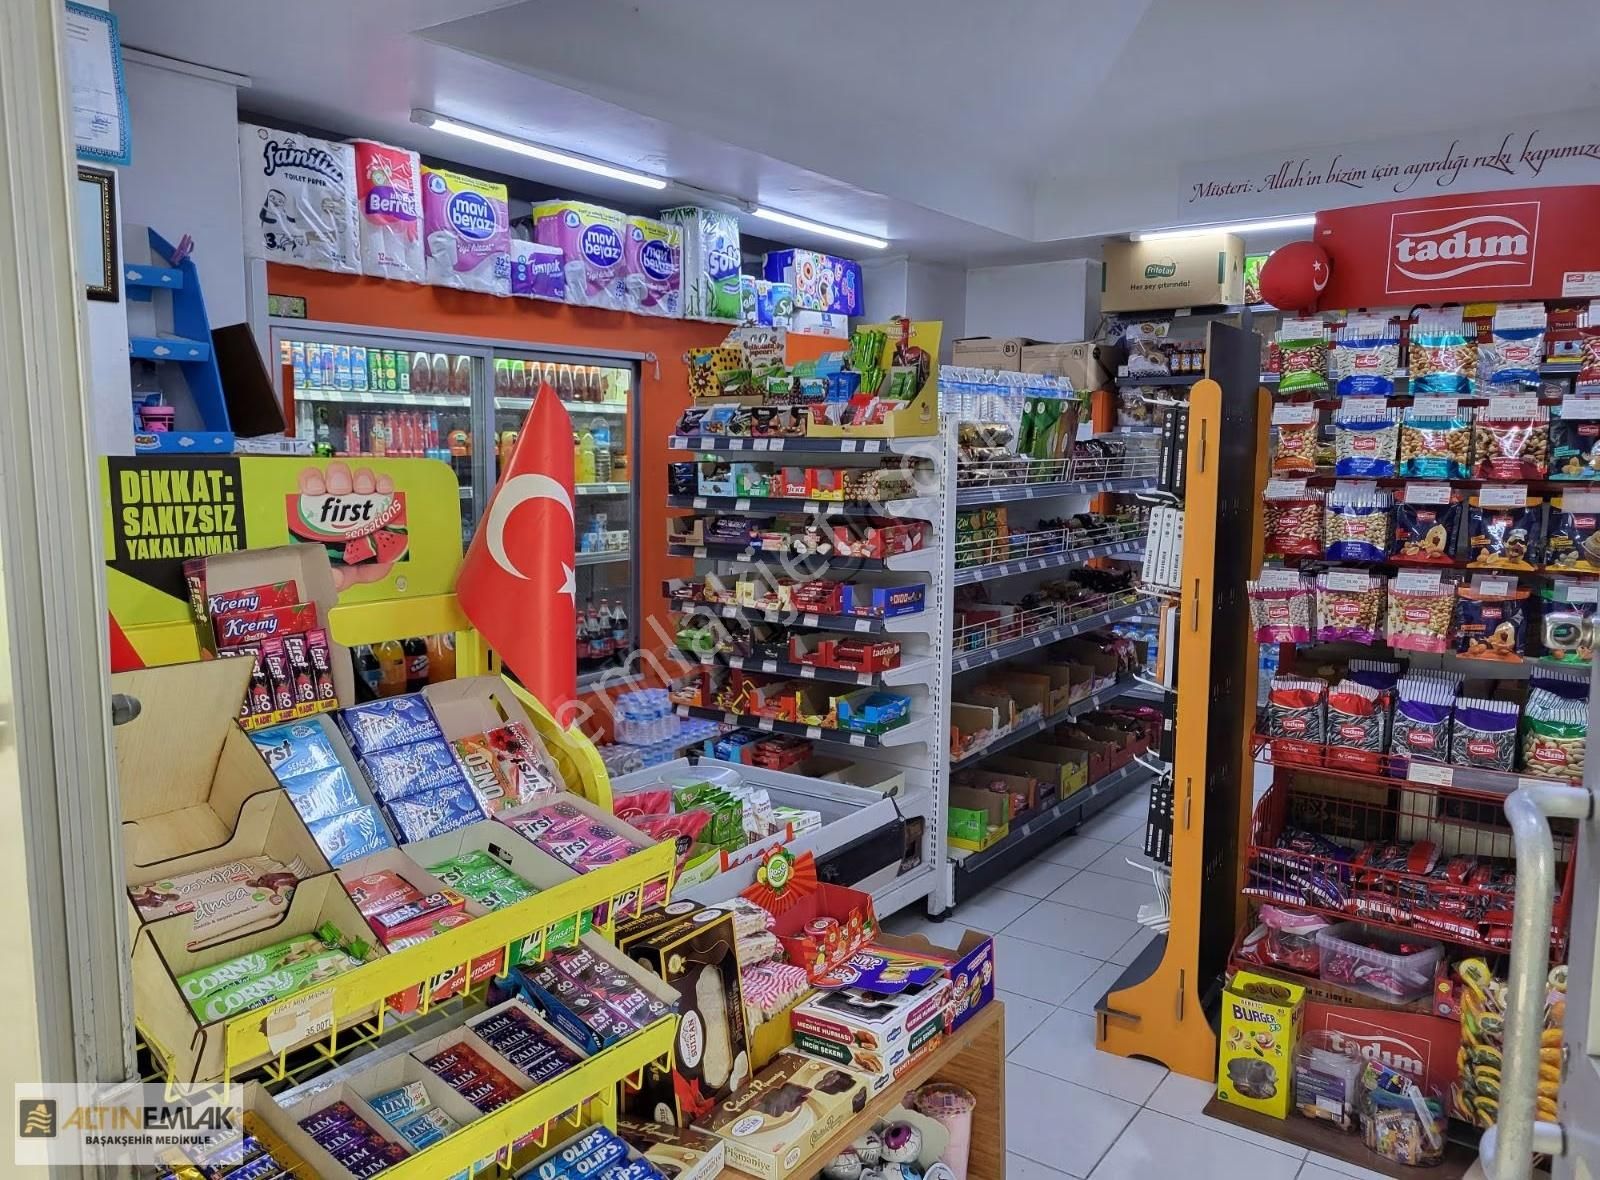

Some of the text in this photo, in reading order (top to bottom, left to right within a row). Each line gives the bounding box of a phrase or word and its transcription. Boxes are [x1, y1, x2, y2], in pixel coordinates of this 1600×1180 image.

[263, 140, 344, 183] familia
[284, 172, 327, 187] TOILET PAPER
[455, 199, 488, 218] mavi
[452, 207, 493, 232] beyaz
[587, 230, 616, 245] mavi
[1395, 230, 1529, 263] tadım
[585, 243, 619, 262] beyaz
[645, 247, 668, 261] mavi
[122, 504, 237, 537] SAKIZSIZ
[320, 497, 374, 523] first
[345, 499, 402, 540] sensations
[126, 534, 239, 561] YAKALANMA!
[208, 595, 260, 614] Kremy
[1336, 605, 1359, 613] tadım
[1405, 609, 1430, 618] tadım
[225, 617, 278, 638] Kremy
[281, 691, 292, 708] 60
[303, 682, 314, 700] 60
[323, 682, 334, 698] 60
[259, 694, 271, 711] 60
[1341, 727, 1365, 737] tadım
[1409, 733, 1434, 744] tadım
[263, 738, 294, 765] rst
[1536, 748, 1566, 761] tadım
[515, 815, 555, 840] First
[552, 836, 591, 860] First
[439, 866, 465, 887] rst
[193, 886, 251, 925] dımca
[425, 893, 443, 905] 60
[559, 949, 594, 974] First
[594, 961, 610, 974] 60
[182, 954, 263, 999] CORNY
[534, 966, 557, 986] rst
[557, 980, 573, 993] 60
[206, 970, 290, 1021] CORNY
[613, 987, 648, 1014] First
[649, 1000, 664, 1013] 60
[1232, 1004, 1276, 1023] BURGER
[476, 1016, 512, 1039] FALIM
[588, 1007, 611, 1029] rst
[612, 1021, 629, 1035] 60
[494, 1030, 530, 1053] FALIM
[690, 1018, 698, 1059] SULTAN
[428, 1053, 460, 1074] ALIM
[511, 1042, 547, 1064] FALIM
[1330, 1033, 1424, 1076] tadım
[447, 1069, 478, 1090] ALIM
[529, 1058, 564, 1081] FALIM
[464, 1083, 496, 1102] ALIM
[377, 1098, 408, 1116] ALIM
[309, 1115, 335, 1135] LIM
[406, 1118, 430, 1139] LIM
[324, 1131, 352, 1151] LIM
[342, 1147, 370, 1169] LIM
[241, 1158, 275, 1180] ALIM
[354, 1158, 389, 1180] ALIM
